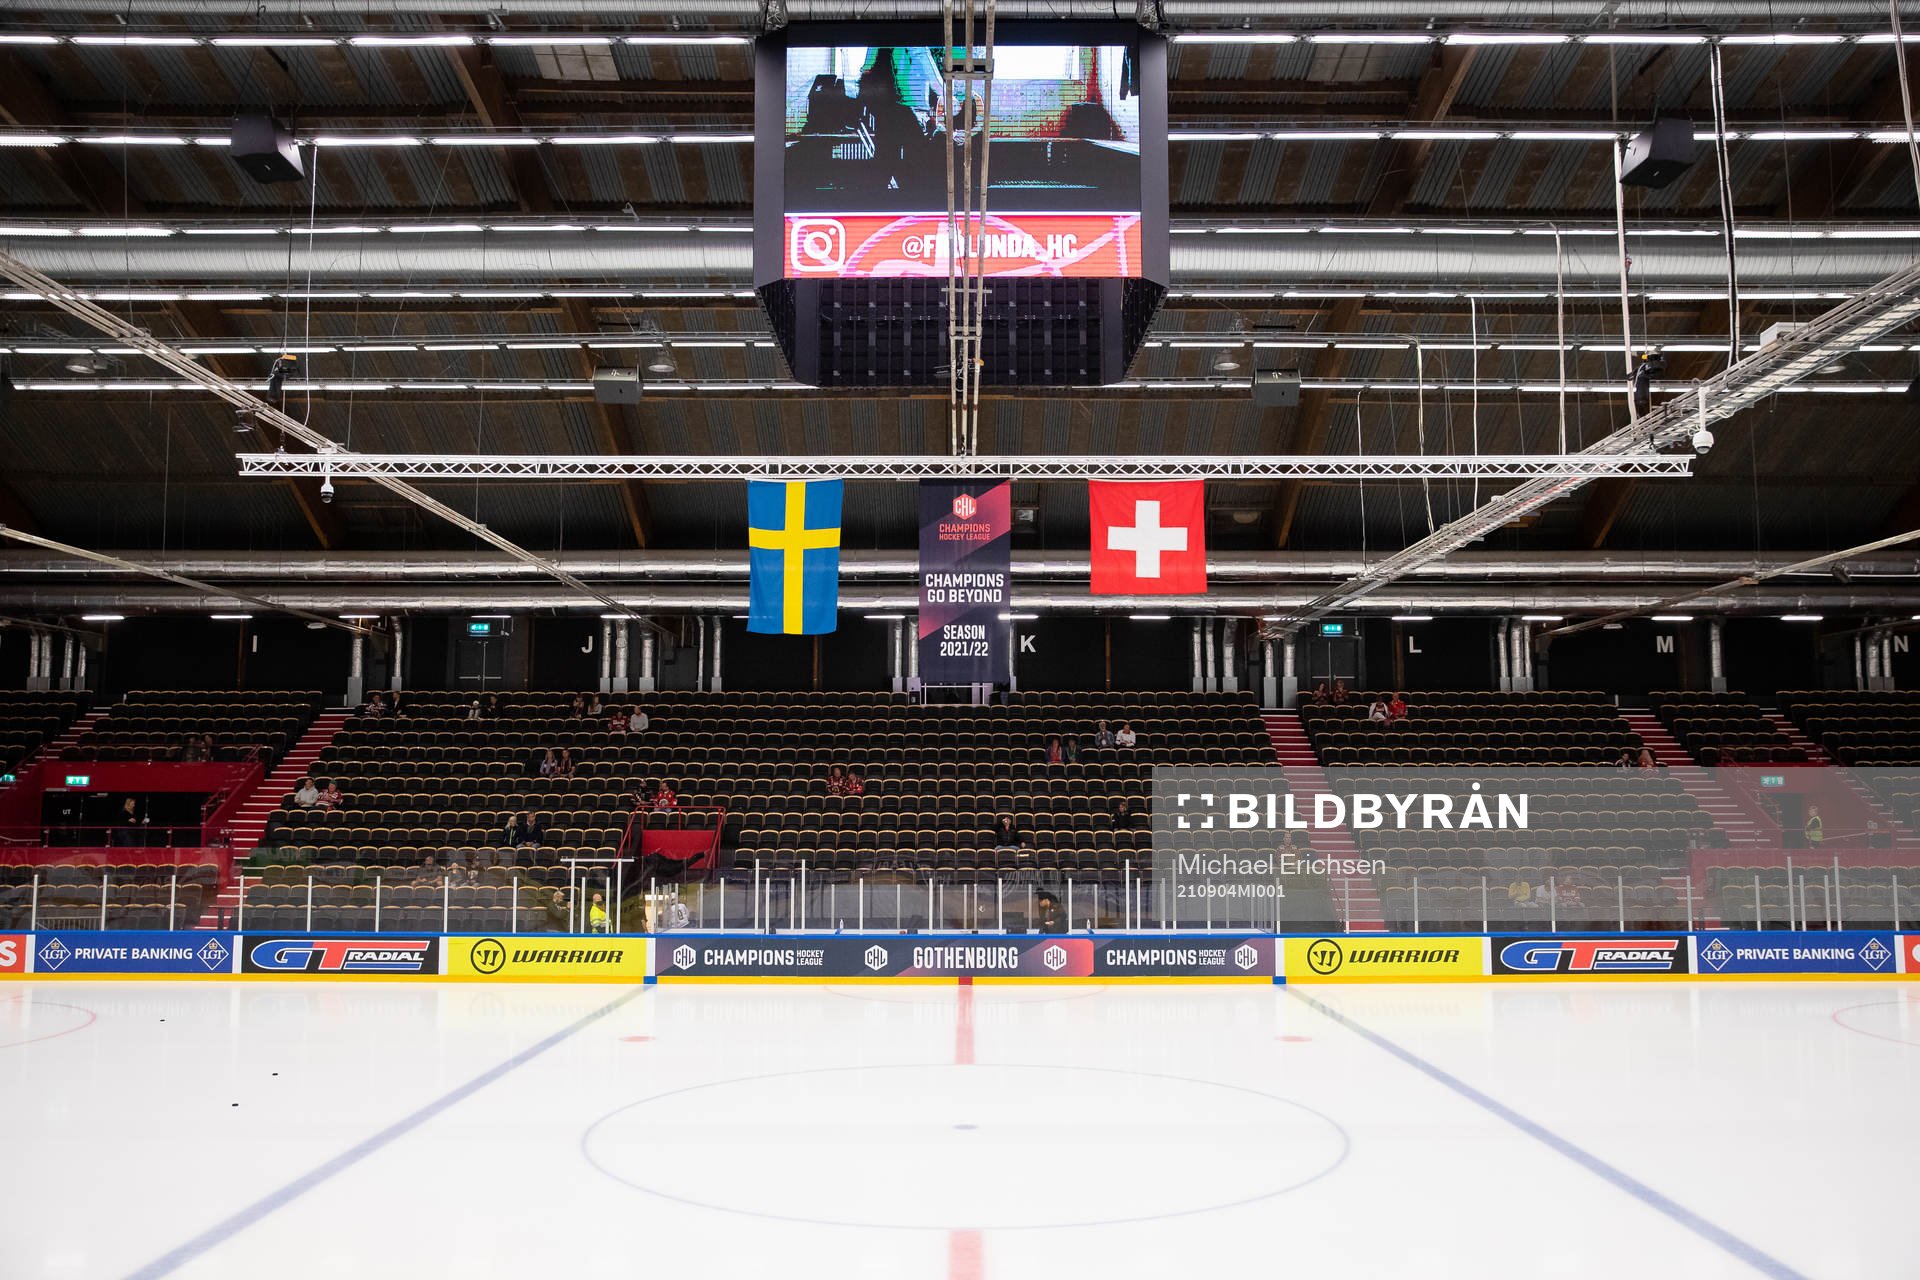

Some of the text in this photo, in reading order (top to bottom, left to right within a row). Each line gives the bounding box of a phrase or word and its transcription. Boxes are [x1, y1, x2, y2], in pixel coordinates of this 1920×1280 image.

[939, 523, 991, 533] CHAMPIONS
[939, 533, 991, 541] HOCKEY LEAGUE
[925, 573, 1004, 588] CHAMPIONS
[927, 588, 1003, 603] GO BEYOND
[943, 624, 985, 640] SEASON
[581, 635, 593, 654] J
[940, 641, 989, 657] 2021/22
[1020, 635, 1037, 653] K
[1409, 635, 1422, 654] L
[1656, 635, 1674, 653] M
[1894, 635, 1909, 653] N
[44, 949, 67, 960] LGT
[75, 948, 193, 960] PRIVATE BANKING
[202, 949, 225, 960] LGT
[250, 939, 430, 970] GT RADIAL
[512, 950, 623, 963] WARRIOR
[704, 949, 794, 966] CHAMPIONS
[796, 949, 824, 958] HOCKEY
[913, 946, 1018, 969] GOTHENBURG
[1106, 949, 1197, 966] CHAMPIONS
[1199, 949, 1227, 958] HOCKEY
[1349, 950, 1460, 963] WARRIOR
[1500, 939, 1679, 970] GT RADIAL
[1706, 949, 1729, 960] LGT
[1736, 948, 1855, 960] PRIVATE BANKING
[1864, 949, 1887, 960] LGT
[796, 958, 823, 966] LEAGUE
[1199, 958, 1226, 966] LEAGUE
